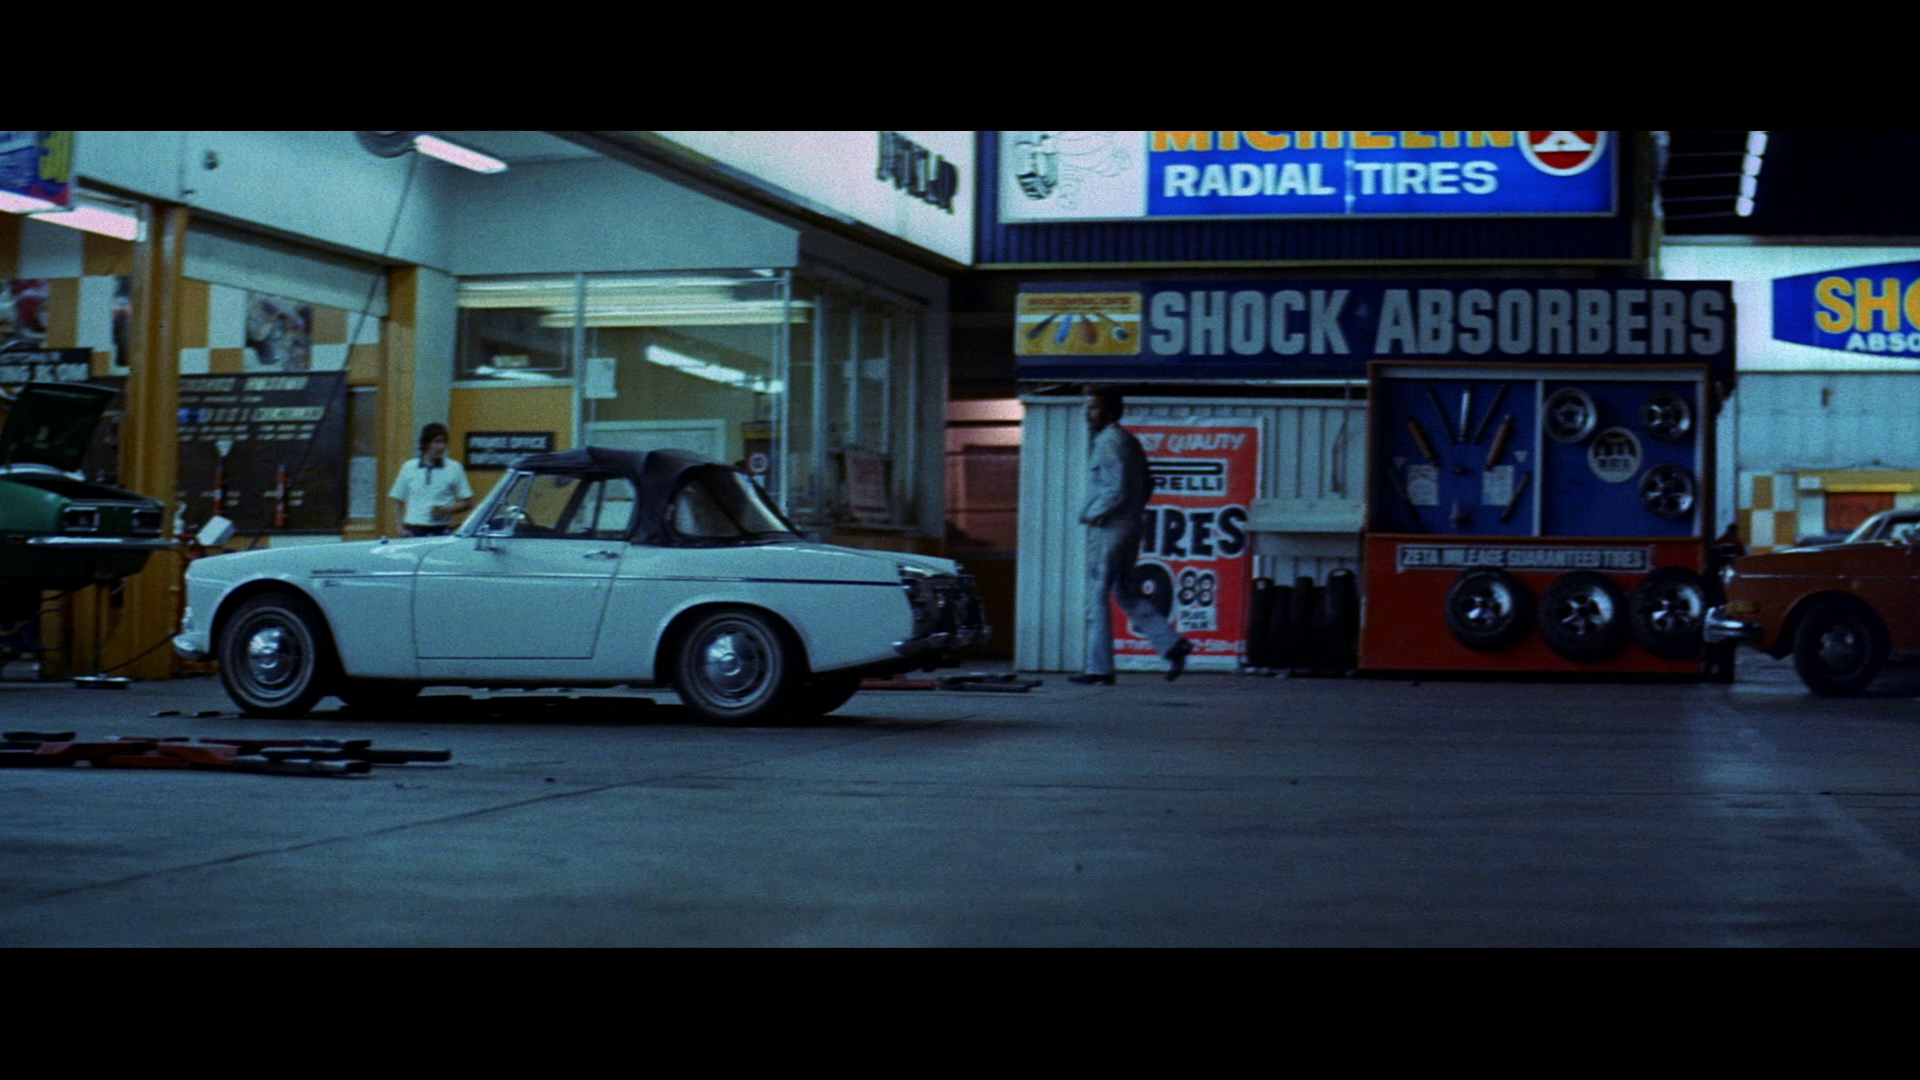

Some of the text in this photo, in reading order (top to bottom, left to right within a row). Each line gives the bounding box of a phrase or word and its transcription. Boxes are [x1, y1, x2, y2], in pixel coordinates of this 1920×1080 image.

[1163, 159, 1498, 197] RADIAL TIRES
[1149, 289, 1724, 357] SHOCK ABSORBERS
[1167, 433, 1246, 453] QUALITY
[1143, 507, 1247, 555] IRES
[1402, 549, 1439, 566] ZETA
[1507, 551, 1600, 568] GUARANTEED
